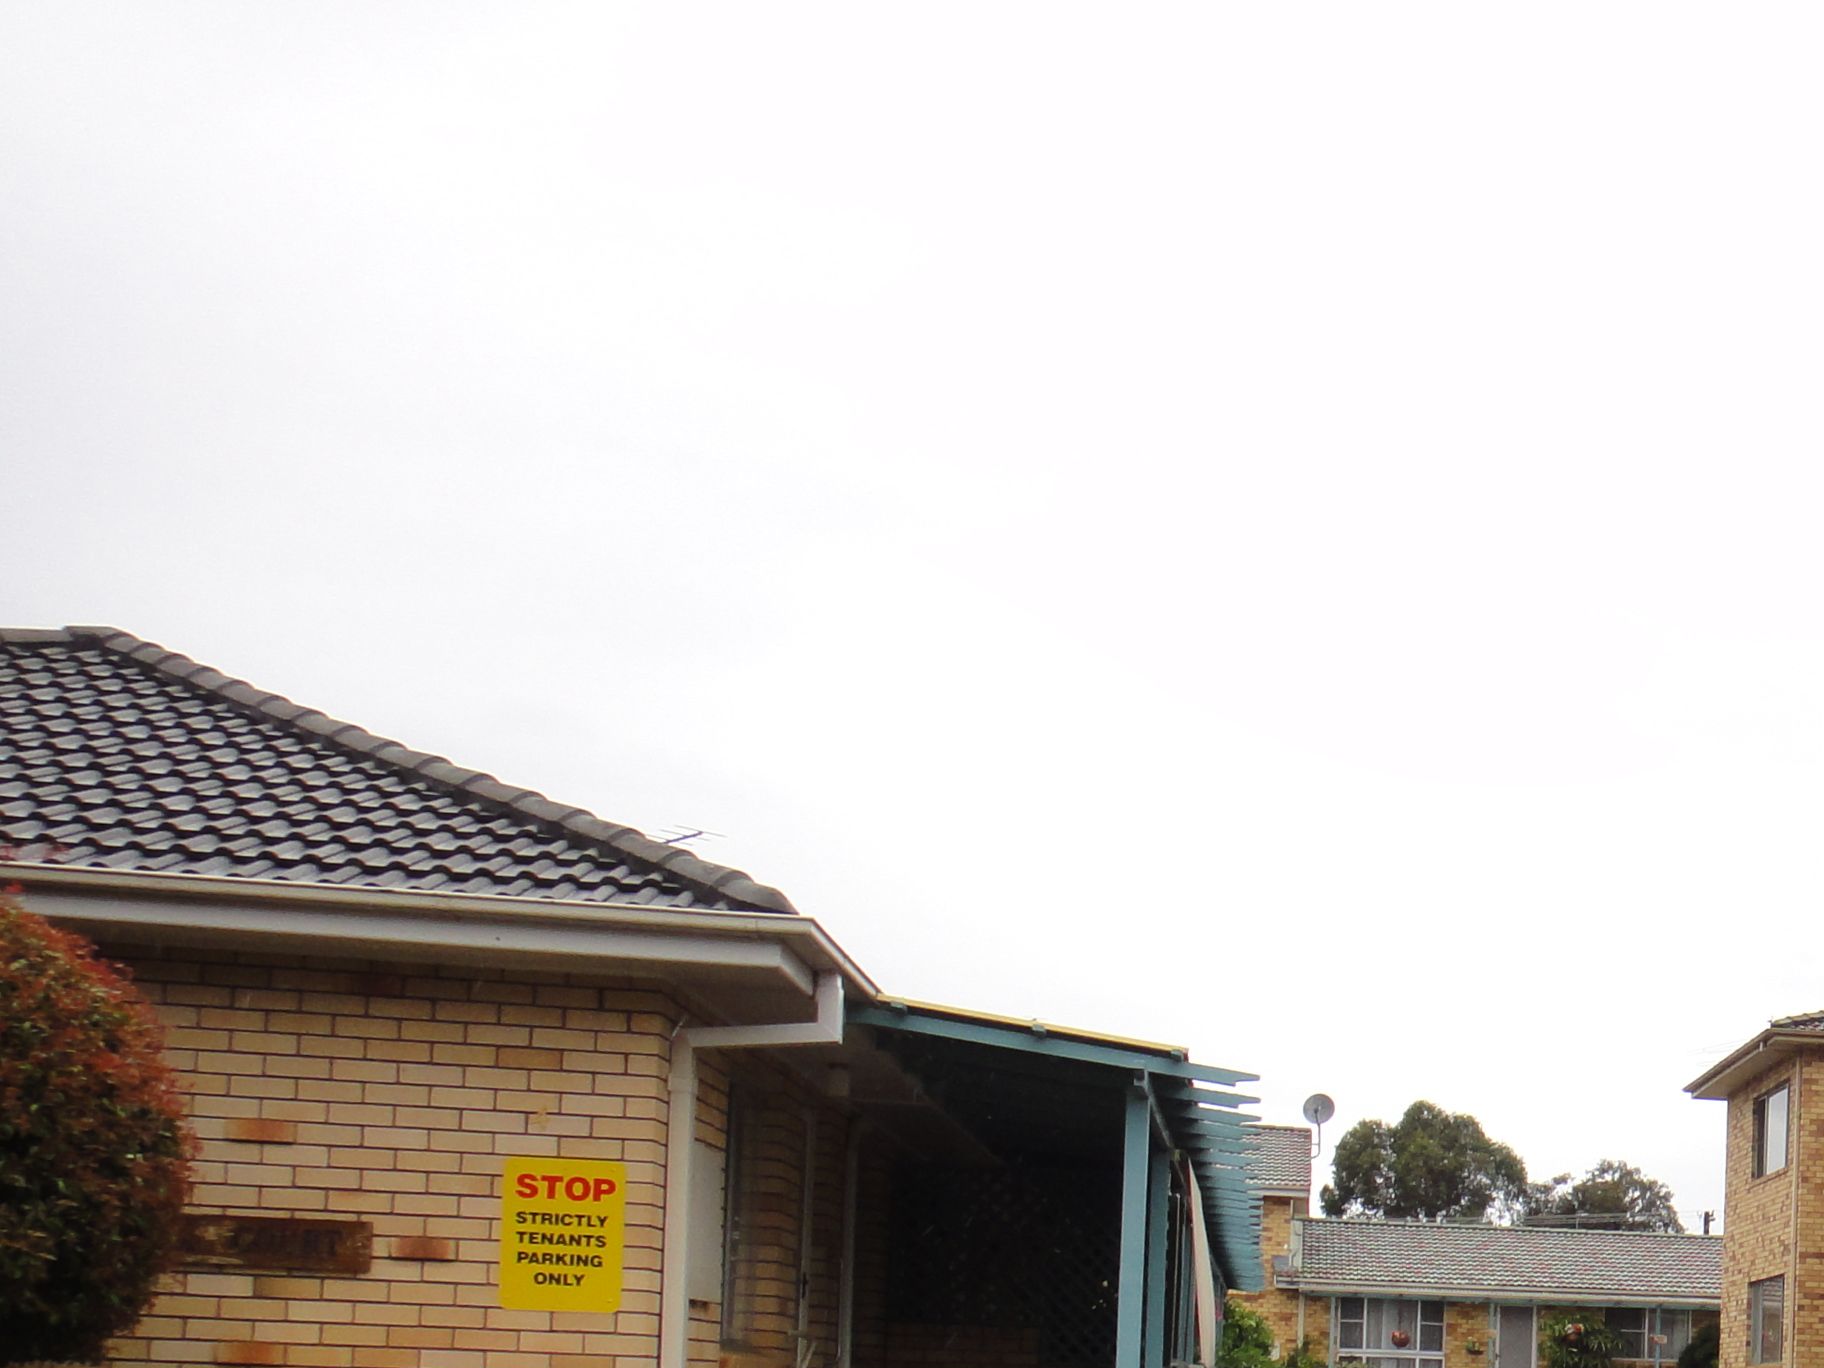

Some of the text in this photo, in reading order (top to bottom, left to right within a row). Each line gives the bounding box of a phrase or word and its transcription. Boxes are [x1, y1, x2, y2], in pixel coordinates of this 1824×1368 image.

[515, 1173, 617, 1202] STOP
[515, 1211, 608, 1228] STRICTLY
[516, 1231, 607, 1248] TENANTS
[516, 1251, 603, 1268] PARKING
[533, 1272, 585, 1287] ONLY
